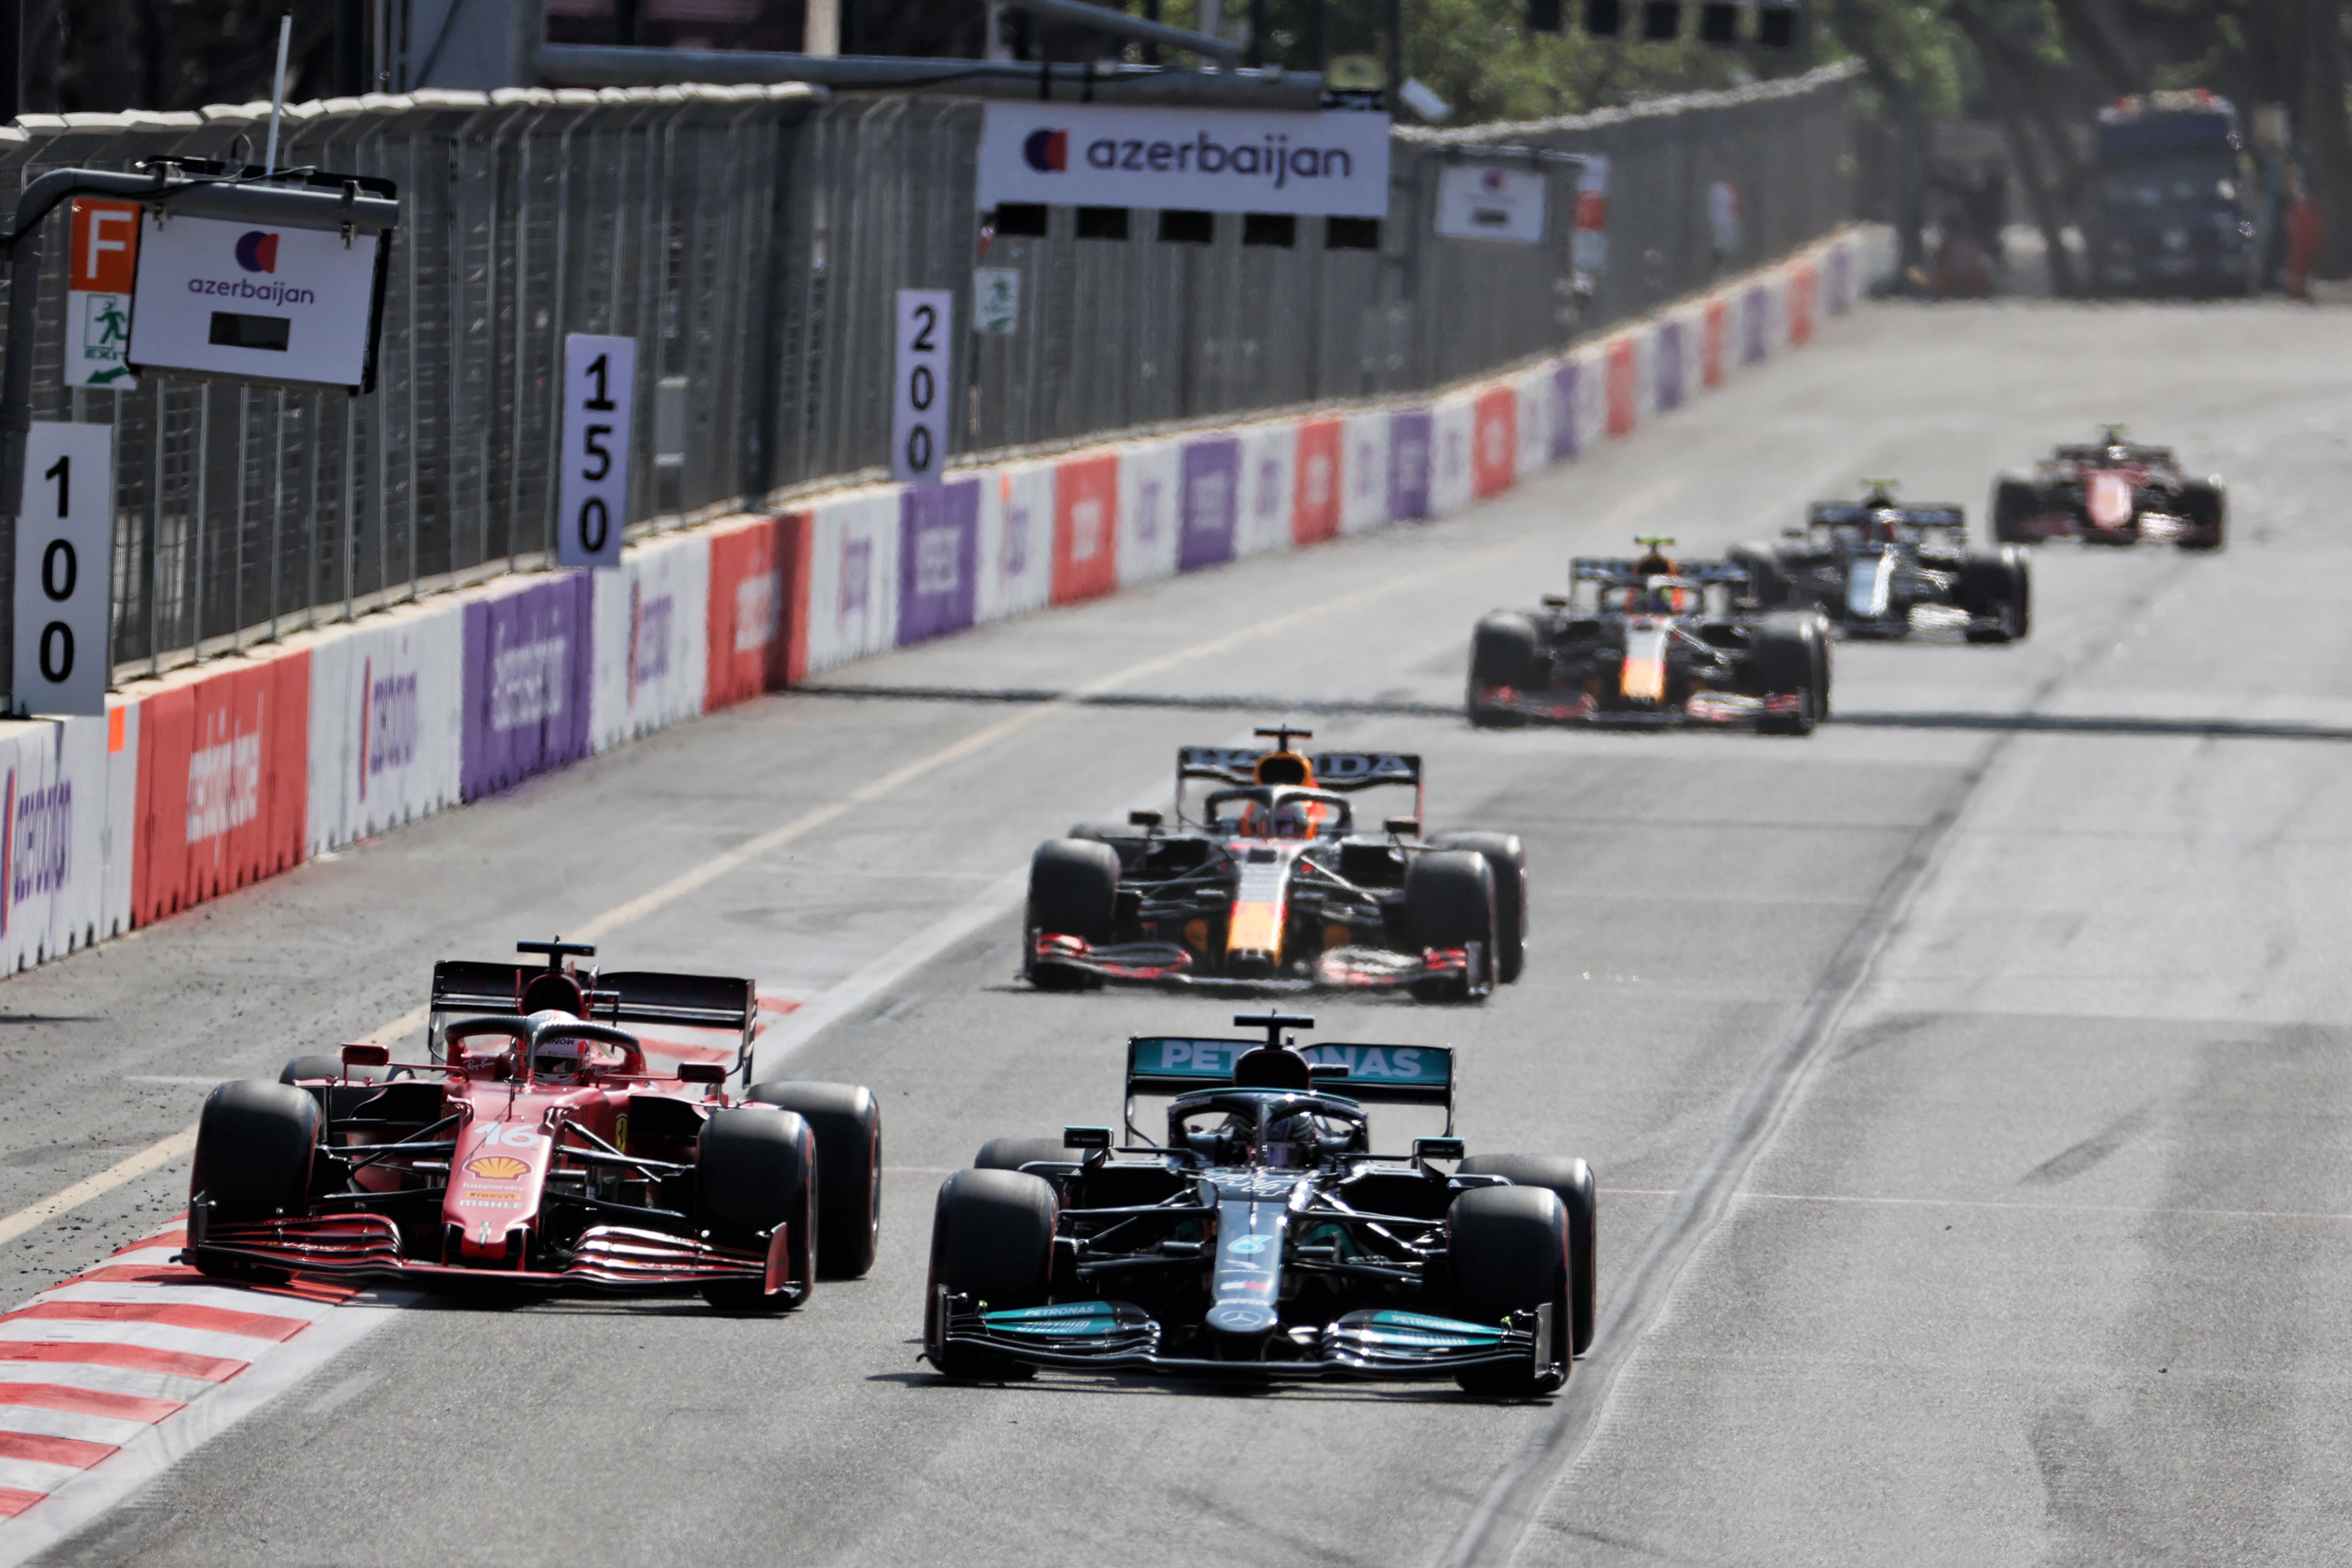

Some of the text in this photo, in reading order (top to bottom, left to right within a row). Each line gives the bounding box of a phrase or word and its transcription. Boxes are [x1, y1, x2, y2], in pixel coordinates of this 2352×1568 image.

[1086, 130, 1351, 189] azerbaijan
[86, 209, 132, 279] F
[188, 277, 315, 307] azerbaijan
[907, 303, 936, 472] 200
[578, 352, 616, 553] 150
[40, 454, 78, 683] 100
[473, 1122, 540, 1147] 16
[1025, 1305, 1095, 1316] PETRONAS
